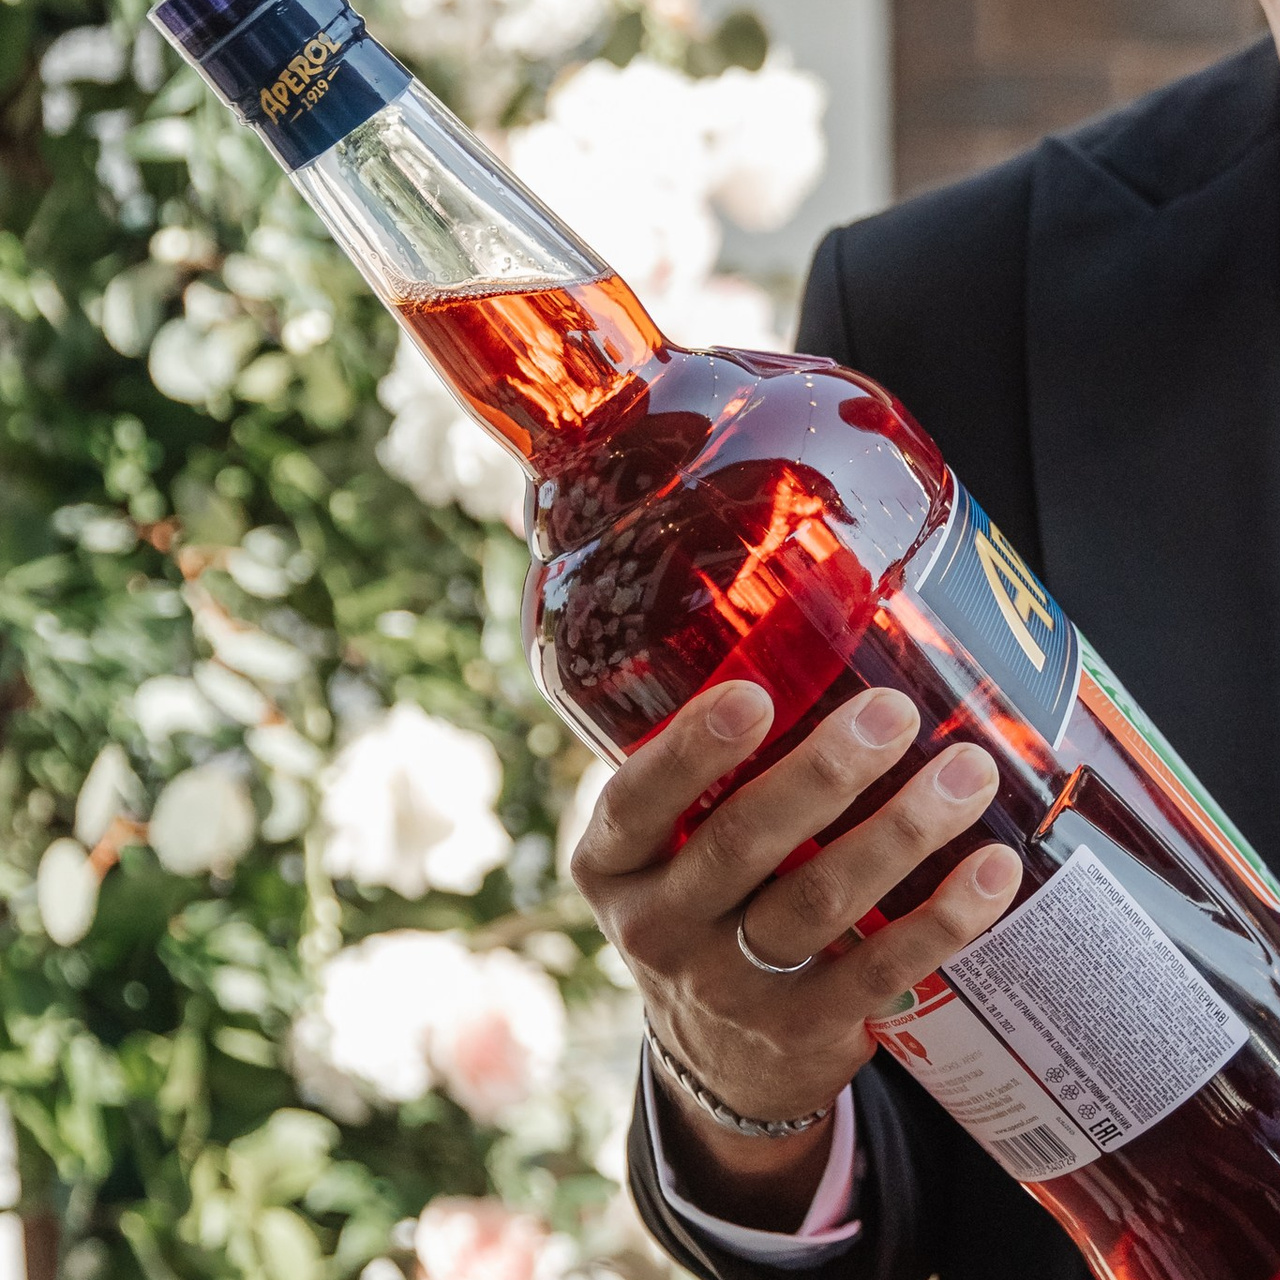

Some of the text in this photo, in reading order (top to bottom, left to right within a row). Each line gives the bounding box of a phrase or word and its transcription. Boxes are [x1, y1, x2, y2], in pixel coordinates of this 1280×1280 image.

[260, 31, 342, 125] APEROL
[301, 79, 329, 111] 1919
[1085, 863, 1125, 906] СПИРТНОЙ
[1119, 902, 1154, 940] НАПИТОК
[1150, 936, 1192, 982] «АПЕРОЛЬ»
[1185, 977, 1230, 1026] (АПЕРИТИВ)
[948, 961, 1016, 1034] ДАТА РОЗЛИВА: 28.01.2022
[959, 955, 984, 981] ОБЪЕМ:
[978, 977, 992, 991] 3,0
[968, 949, 988, 968] СРОК
[981, 963, 1011, 995] ГОДНОСТИ
[1006, 990, 1018, 1003] НЕ
[1012, 998, 1045, 1033] ОГРАНИЧЕН
[1039, 1028, 1055, 1044] ПРИ
[1048, 1039, 1087, 1080] СОБЛЮДЕНИИ
[1081, 1074, 1110, 1105] УСЛОВИЙ
[1088, 1114, 1123, 1149] EAC
[1045, 1154, 1076, 1173] 340729
